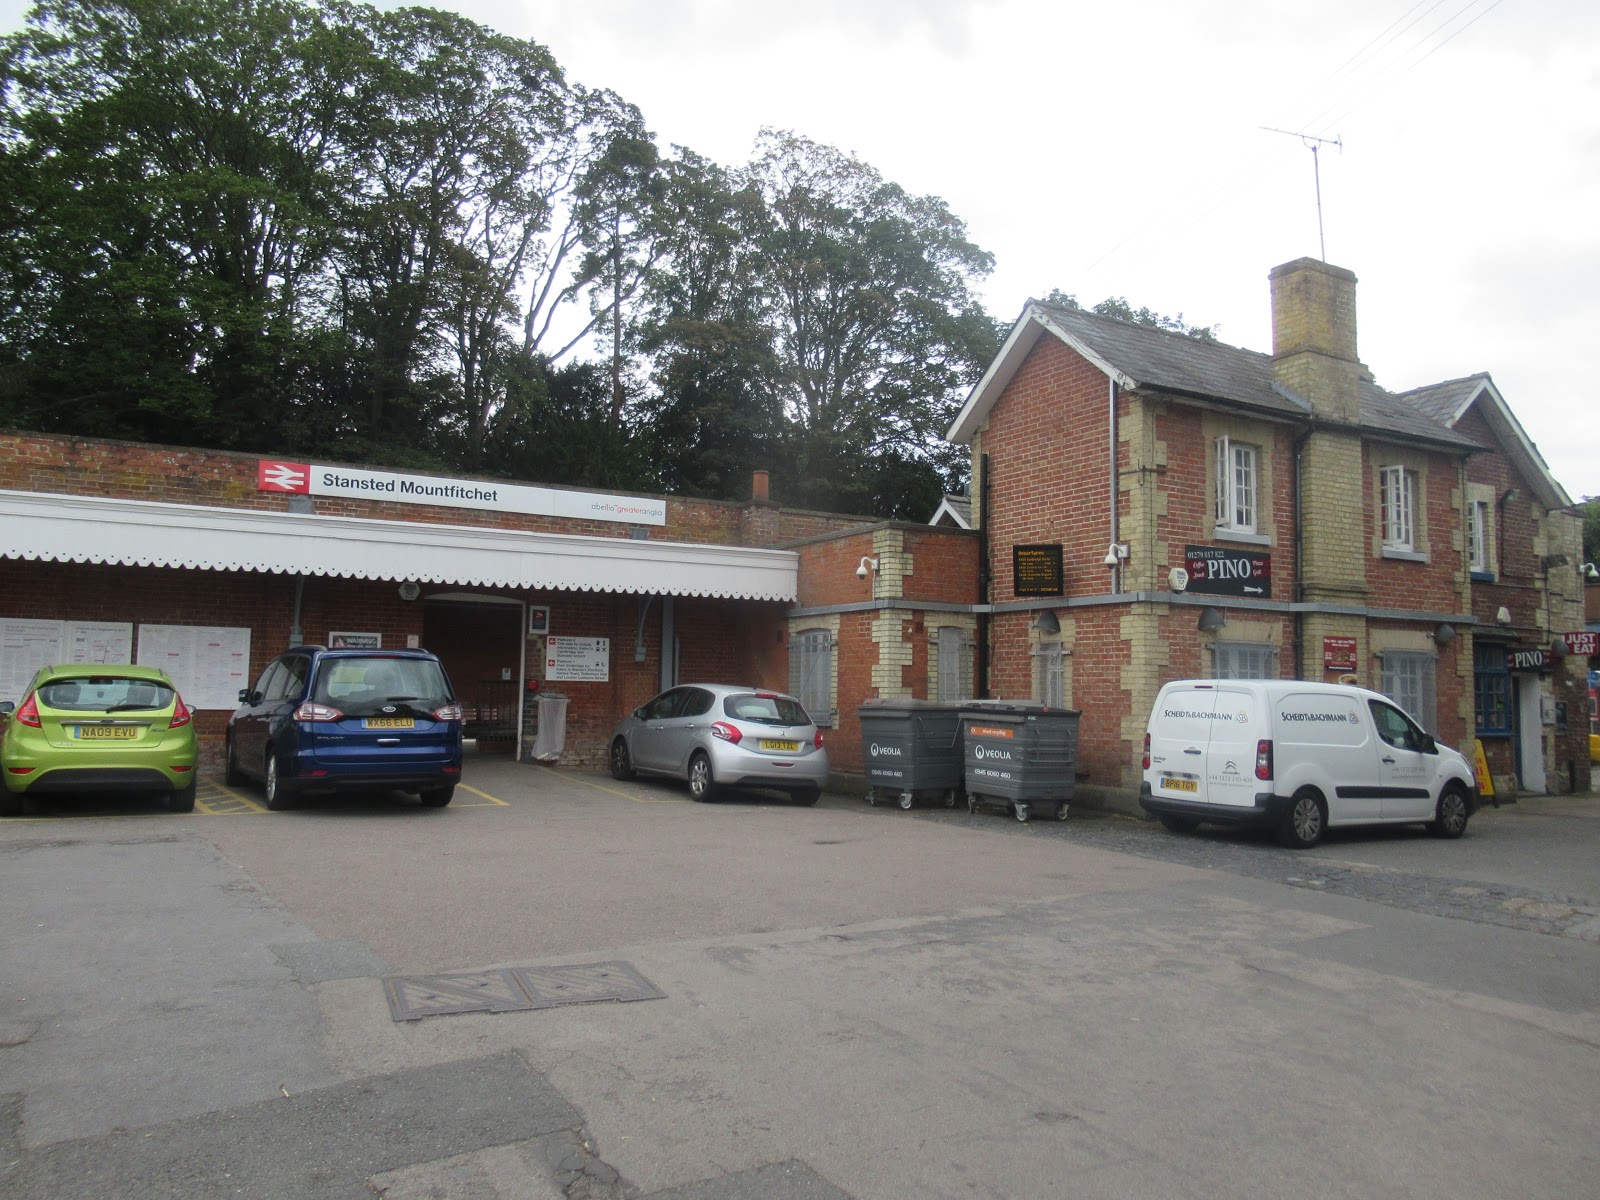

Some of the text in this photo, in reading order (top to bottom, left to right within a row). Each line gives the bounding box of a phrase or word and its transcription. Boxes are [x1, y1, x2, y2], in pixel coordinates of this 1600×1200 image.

[323, 473, 498, 501] Stansted Mountfitchet
[591, 503, 614, 512] abellio
[1188, 551, 1204, 559] 01279
[1207, 558, 1251, 579] PINO
[1567, 633, 1596, 644] JUST
[1574, 644, 1596, 654] EAT
[1514, 650, 1542, 668] PINO
[367, 718, 412, 727] WX66 ELU
[82, 728, 136, 737] NA09 EVU
[879, 746, 901, 756] VEOLIA
[985, 750, 1012, 760] VEOLIA
[1165, 779, 1180, 788] BP16
